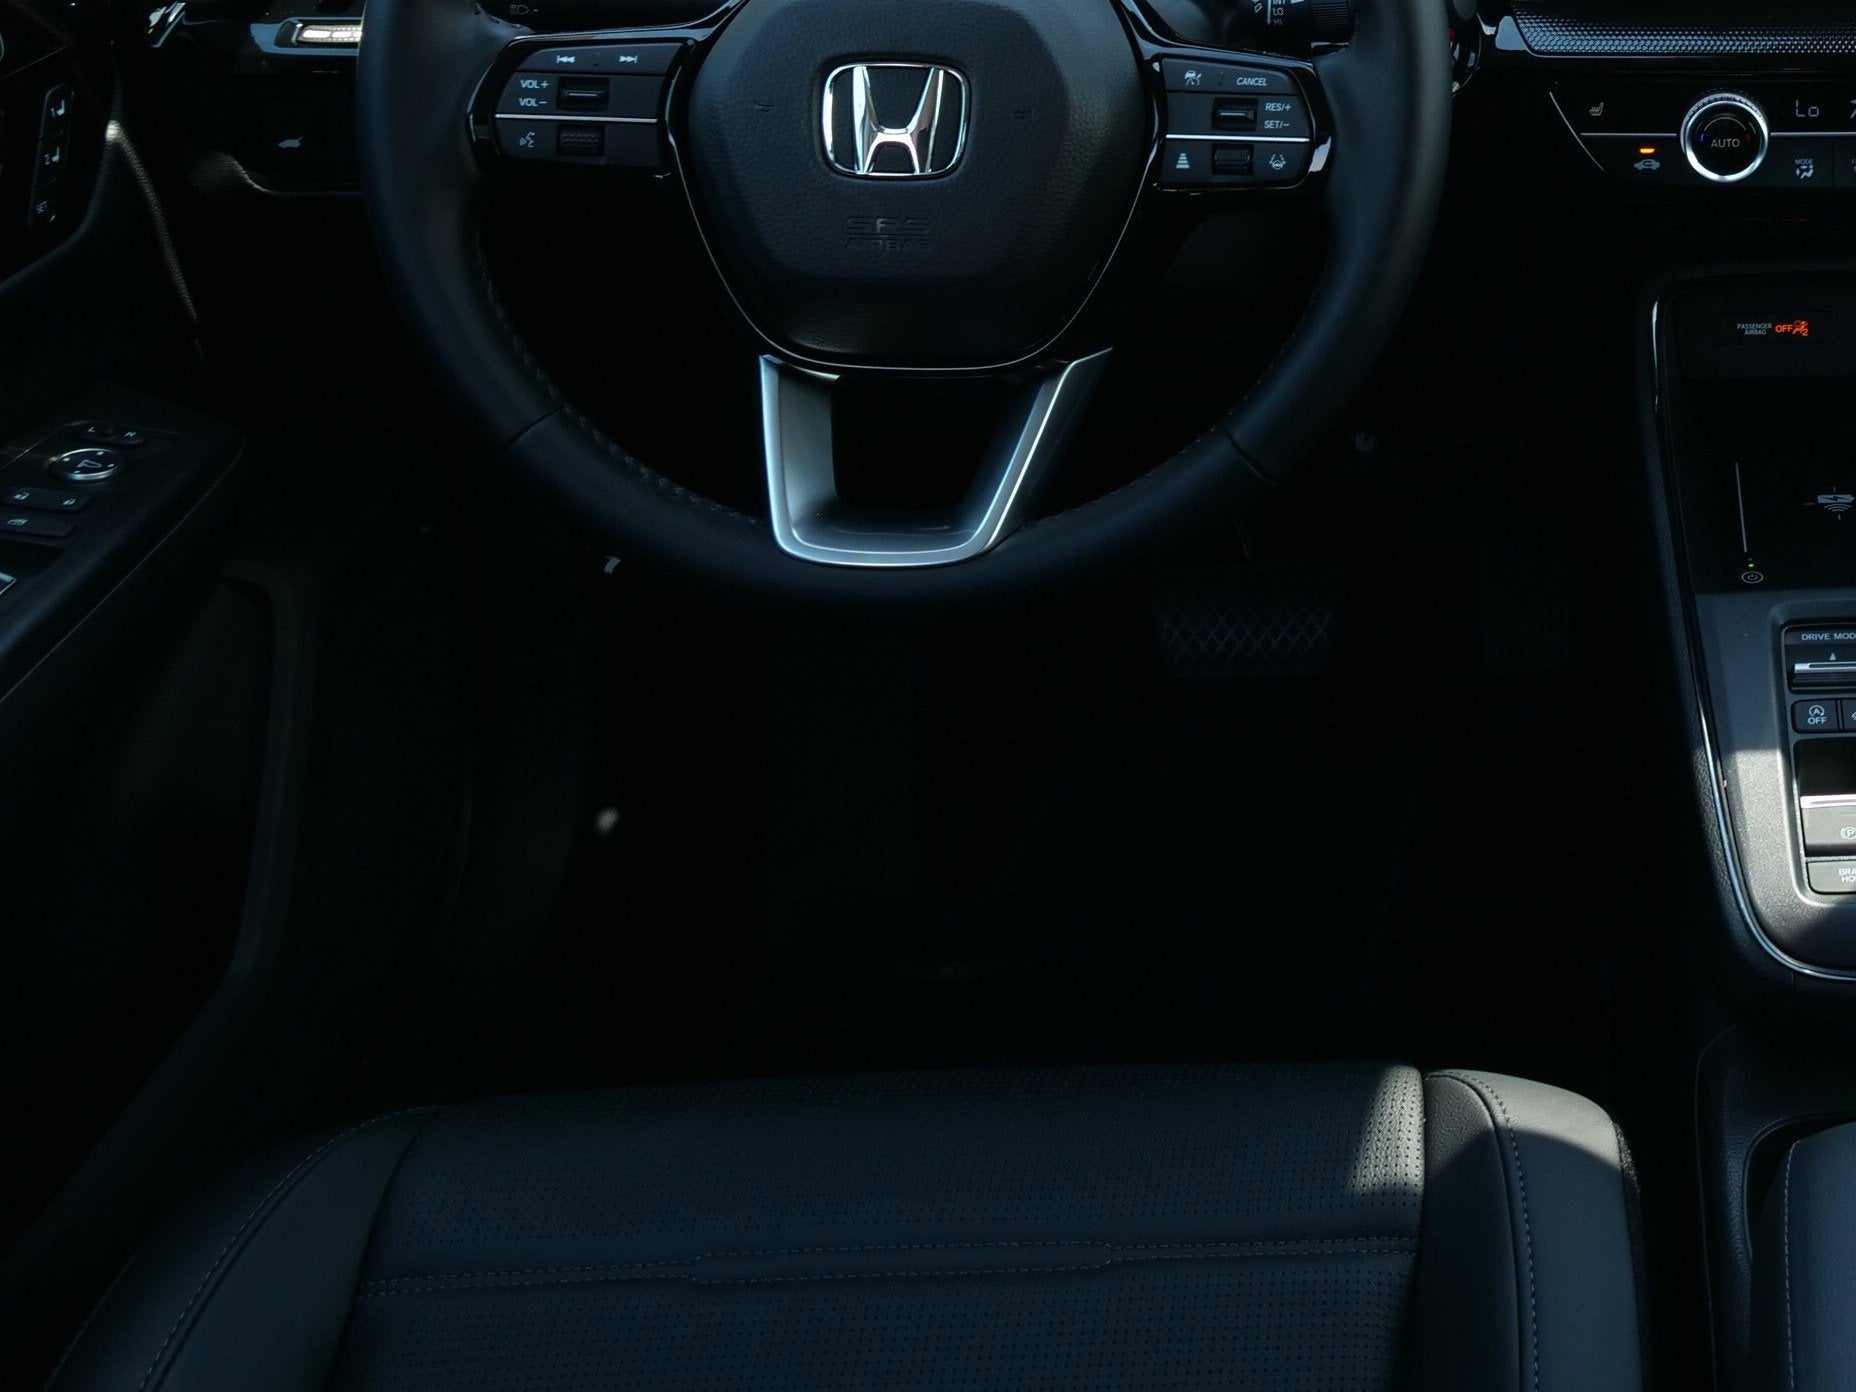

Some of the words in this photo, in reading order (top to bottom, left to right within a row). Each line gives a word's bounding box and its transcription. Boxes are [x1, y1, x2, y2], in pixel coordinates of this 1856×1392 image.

[1273, 8, 1284, 16] LO
[1236, 77, 1268, 86] CANCEL
[1265, 102, 1291, 111] RES/+
[1711, 139, 1741, 148] AUTO
[1775, 324, 1793, 333] OFF
[1801, 633, 1830, 641] DRIVE
